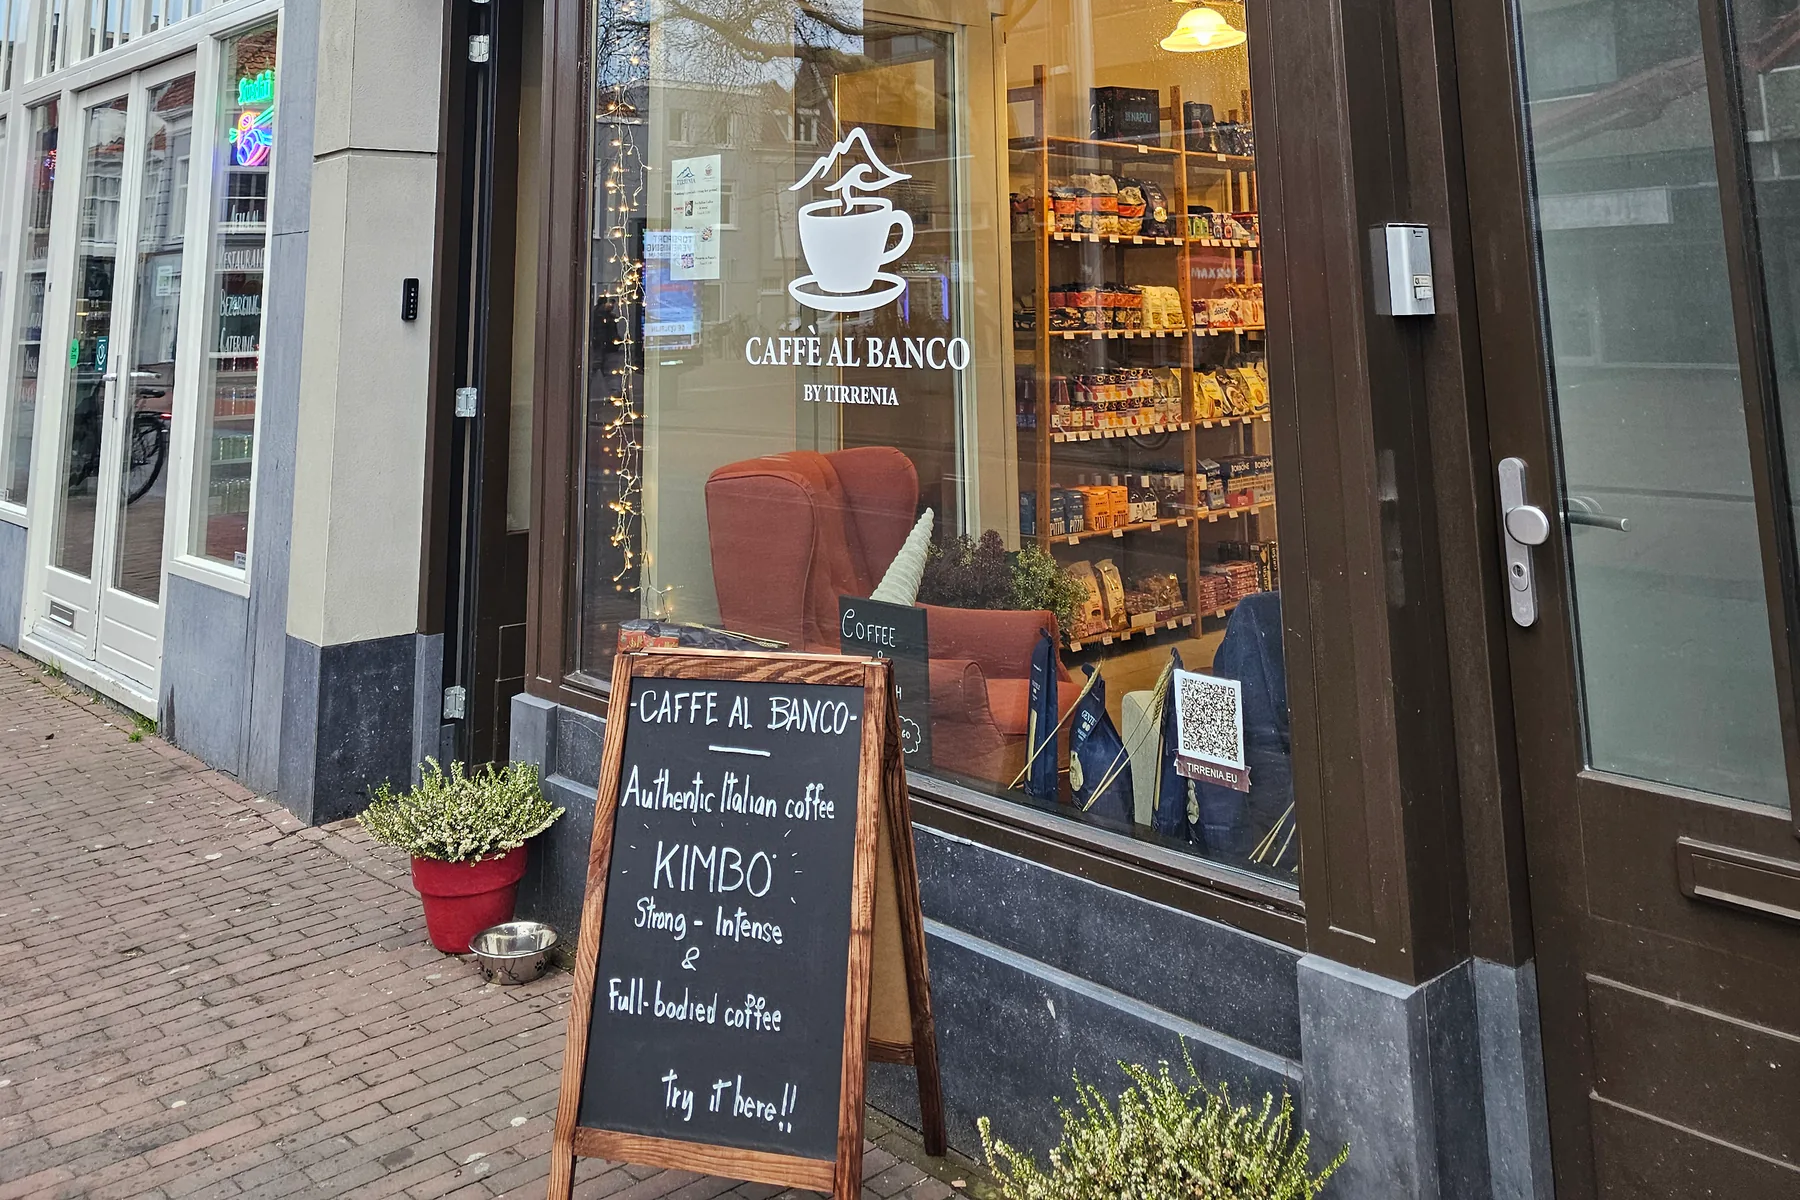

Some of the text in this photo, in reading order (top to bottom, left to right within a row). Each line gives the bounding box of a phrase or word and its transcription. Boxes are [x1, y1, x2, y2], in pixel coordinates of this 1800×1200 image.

[219, 327, 256, 353] CATERING
[745, 325, 971, 370] CAFFÈ AL BANCO
[803, 384, 899, 406] BY TIRRENIA
[728, 695, 753, 730] AL
[621, 764, 835, 821] Authentic Italian coffee
[1186, 762, 1238, 784] TIRRENIA.EU
[653, 840, 772, 898] KIMBO
[634, 895, 687, 941] Strong
[715, 905, 783, 945] Intense
[681, 946, 700, 971] &
[724, 993, 782, 1032] coffee
[709, 1078, 733, 1112] it
[733, 1074, 797, 1134] here!!
